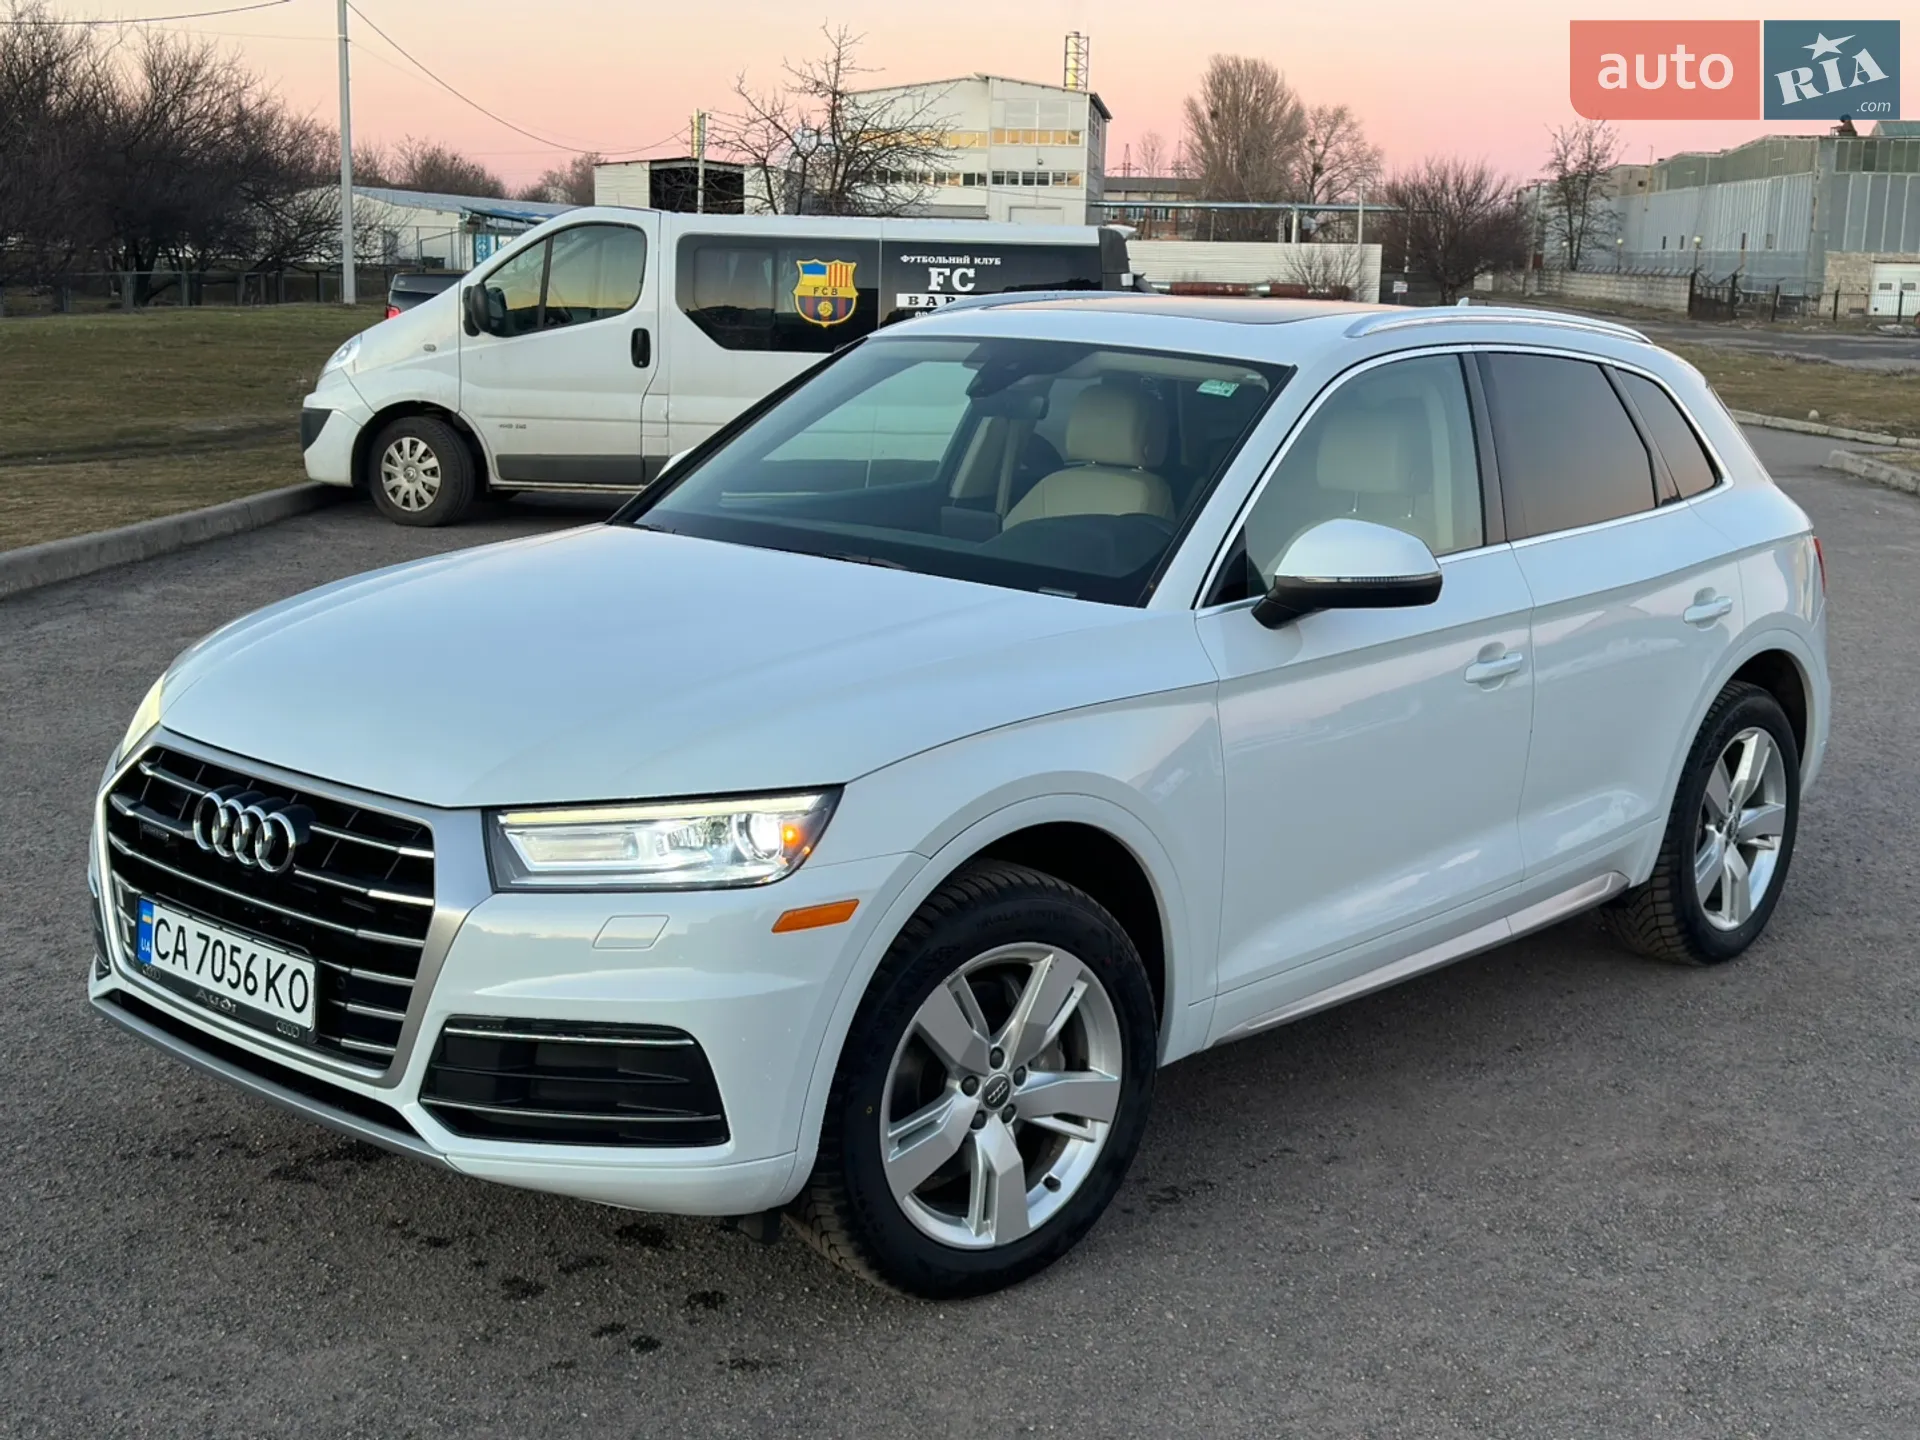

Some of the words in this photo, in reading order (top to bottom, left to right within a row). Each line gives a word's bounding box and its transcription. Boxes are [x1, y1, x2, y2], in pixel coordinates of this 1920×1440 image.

[974, 257, 1001, 265] КЛУБ
[928, 267, 975, 292] FC
[813, 287, 838, 296] FCB
[141, 937, 151, 953] UA
